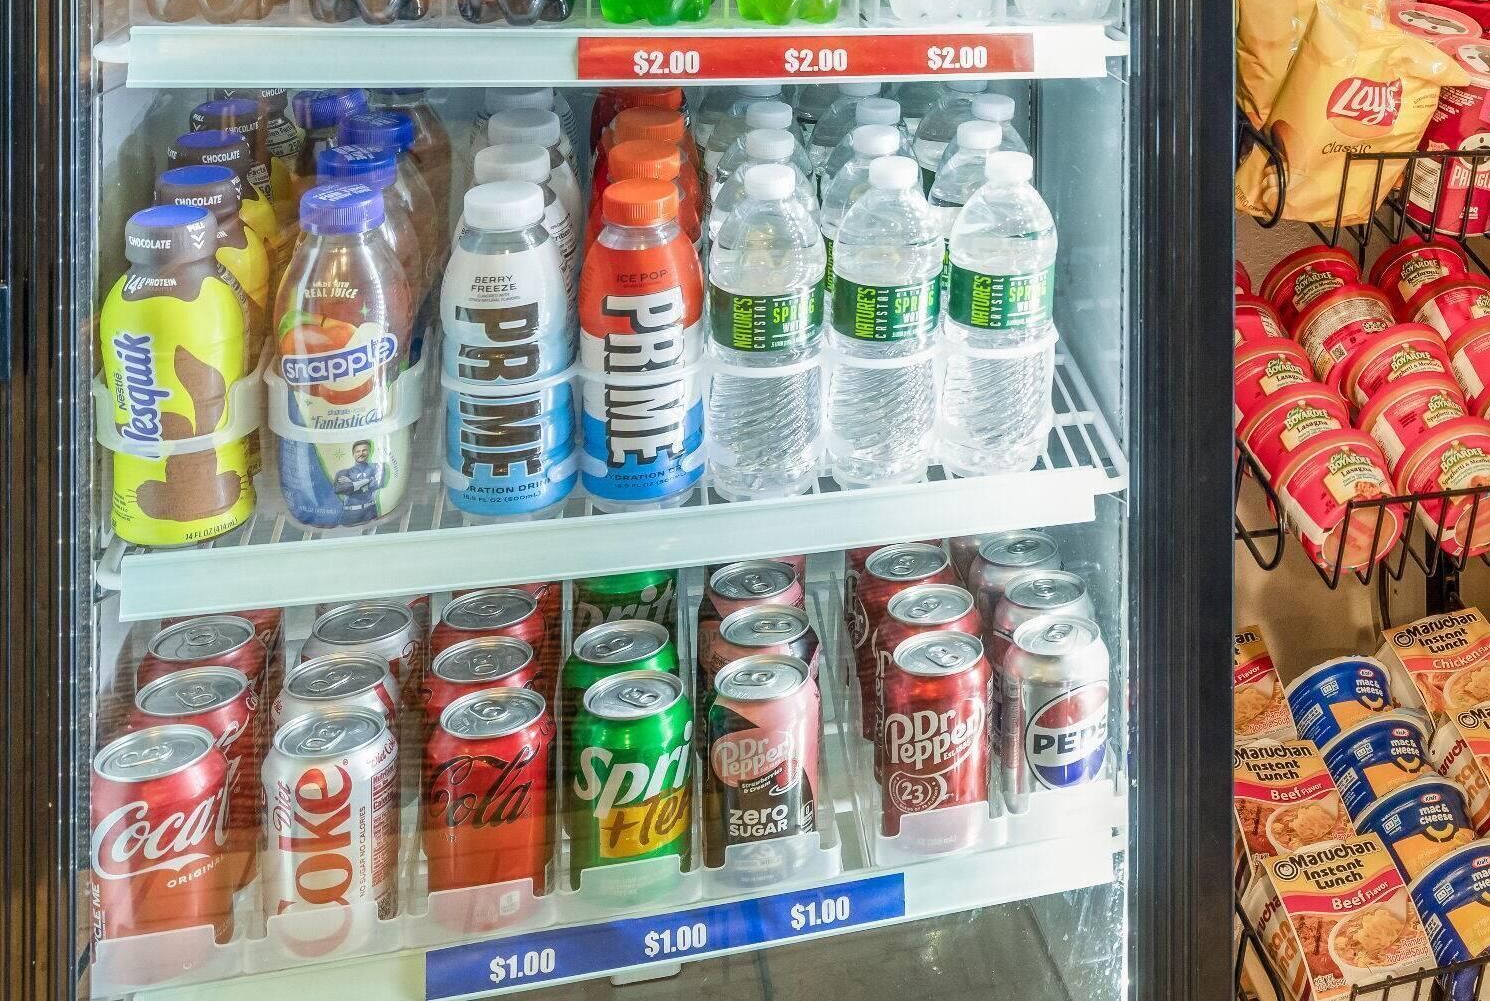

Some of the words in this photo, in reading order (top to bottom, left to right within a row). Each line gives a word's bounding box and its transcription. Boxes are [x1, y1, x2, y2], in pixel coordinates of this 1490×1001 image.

[633, 50, 700, 75] $2.00
[785, 48, 848, 73] $2.00
[927, 46, 987, 70] $2.00
[202, 150, 240, 163] CHOCOLATE
[175, 195, 222, 206] CHOCOLATE
[187, 222, 205, 232] PULL
[129, 236, 171, 249] CHOCOLATE
[145, 278, 177, 287] PROTEIN
[474, 275, 512, 284] BERRY
[616, 274, 636, 283] ICE
[640, 269, 668, 280] POP
[304, 289, 327, 298] REAL
[471, 283, 517, 292] FREEZE
[990, 278, 1004, 327] CRYSTAL
[875, 290, 890, 339] CRYSTAL
[754, 299, 766, 350] CRYSTAL
[1391, 352, 1432, 371] BOYARDEE
[314, 415, 364, 429] Fantastic
[1284, 409, 1330, 428] BOYARDEE
[1296, 420, 1328, 433] Lasagna
[1328, 455, 1372, 474] BOYARDEE
[1440, 448, 1486, 472] BOYARDEE
[1340, 466, 1372, 476] Lasagna
[1442, 464, 1465, 486] Spaghetti
[1408, 613, 1478, 638] Maruchan
[1418, 628, 1468, 647] Instant
[1428, 638, 1469, 653] Lunch
[1433, 650, 1480, 669] Chicken
[1237, 666, 1261, 680] Flavor
[913, 709, 957, 742] Dr
[740, 738, 769, 760] Dr
[884, 714, 980, 770] Pepper
[714, 741, 790, 780] Pepper
[1234, 745, 1312, 760] Maruchan
[1246, 759, 1300, 771] Instant
[742, 767, 782, 788] Strawberries
[1257, 770, 1299, 782] Lunch
[750, 781, 770, 793] Cream
[901, 782, 924, 805] 23
[1271, 787, 1301, 800] Beef
[1301, 782, 1323, 795] Flavor
[273, 780, 292, 832] Diet
[730, 805, 788, 824] zero
[730, 819, 788, 837] SUGAR
[360, 847, 365, 859] NO
[1290, 841, 1378, 868] Maruchan
[1303, 858, 1365, 880] Instant
[1315, 871, 1363, 890] Lunch
[360, 887, 365, 898] NO
[1332, 891, 1367, 910] Beef
[1365, 881, 1388, 899] Flavor
[790, 896, 850, 930] $1.00
[644, 923, 707, 958] $1.00
[490, 949, 555, 984] $1.00
